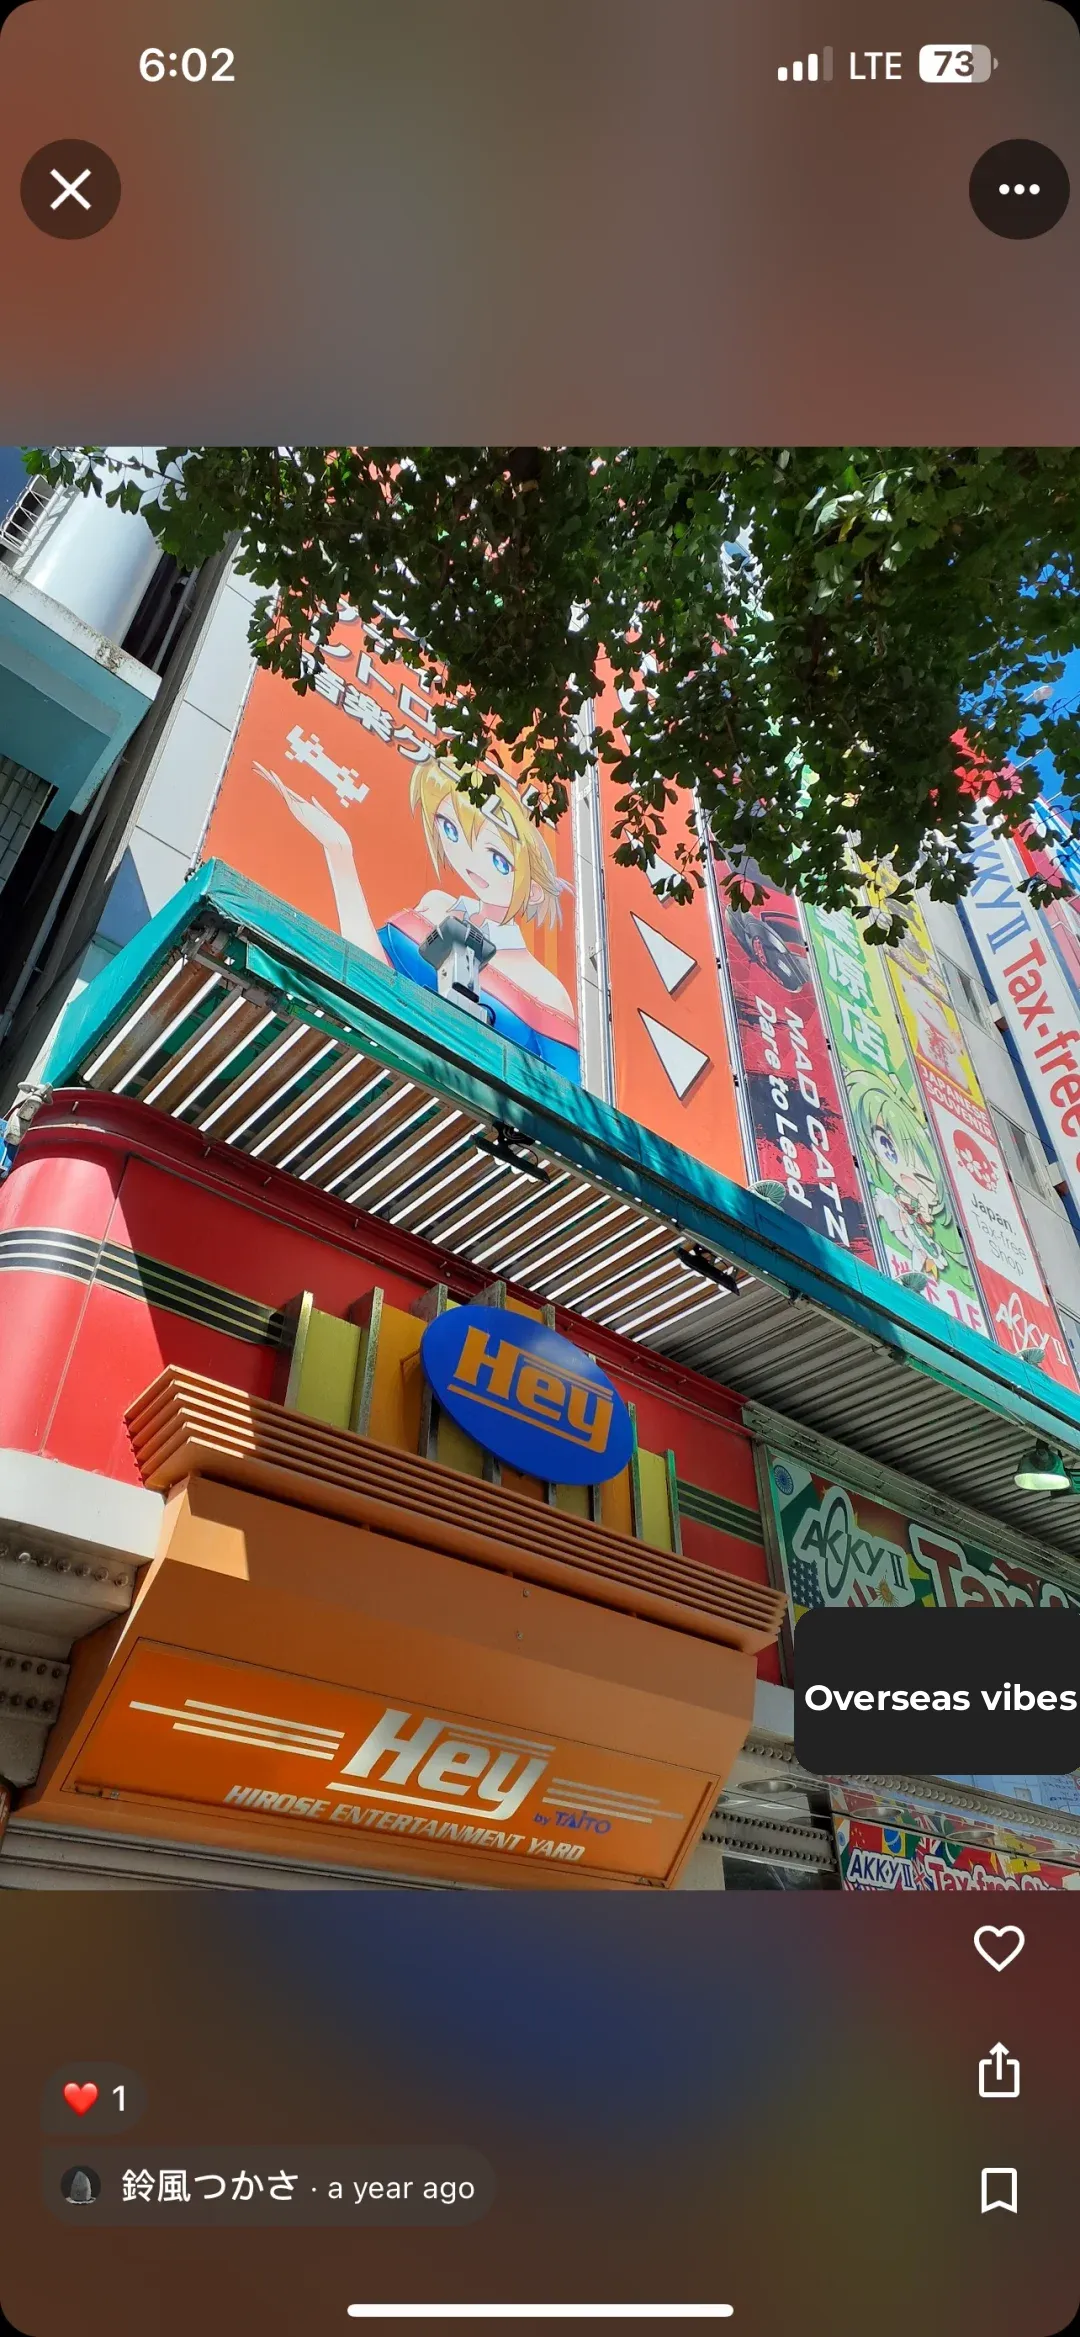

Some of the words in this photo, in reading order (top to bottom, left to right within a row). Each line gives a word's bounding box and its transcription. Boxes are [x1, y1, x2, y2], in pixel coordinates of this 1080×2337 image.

[755, 995, 782, 1070] Dare
[769, 1074, 790, 1111] to
[920, 1064, 989, 1126] JAPANESE
[925, 1080, 995, 1142] SOUVENIR
[784, 1006, 821, 1109] MAD
[806, 1114, 850, 1248] CATZ
[775, 1112, 813, 1209] Lead
[971, 1211, 1027, 1261] Tax-free
[988, 1239, 1024, 1276] Shop
[448, 1325, 614, 1453] Hey
[328, 1708, 555, 1821] Hey
[224, 1785, 328, 1820] HIROSE
[330, 1804, 525, 1853] ENTERTAINMENT
[523, 1837, 586, 1863] YARD
[533, 1812, 549, 1827] by
[849, 1854, 899, 1888] AKKY
